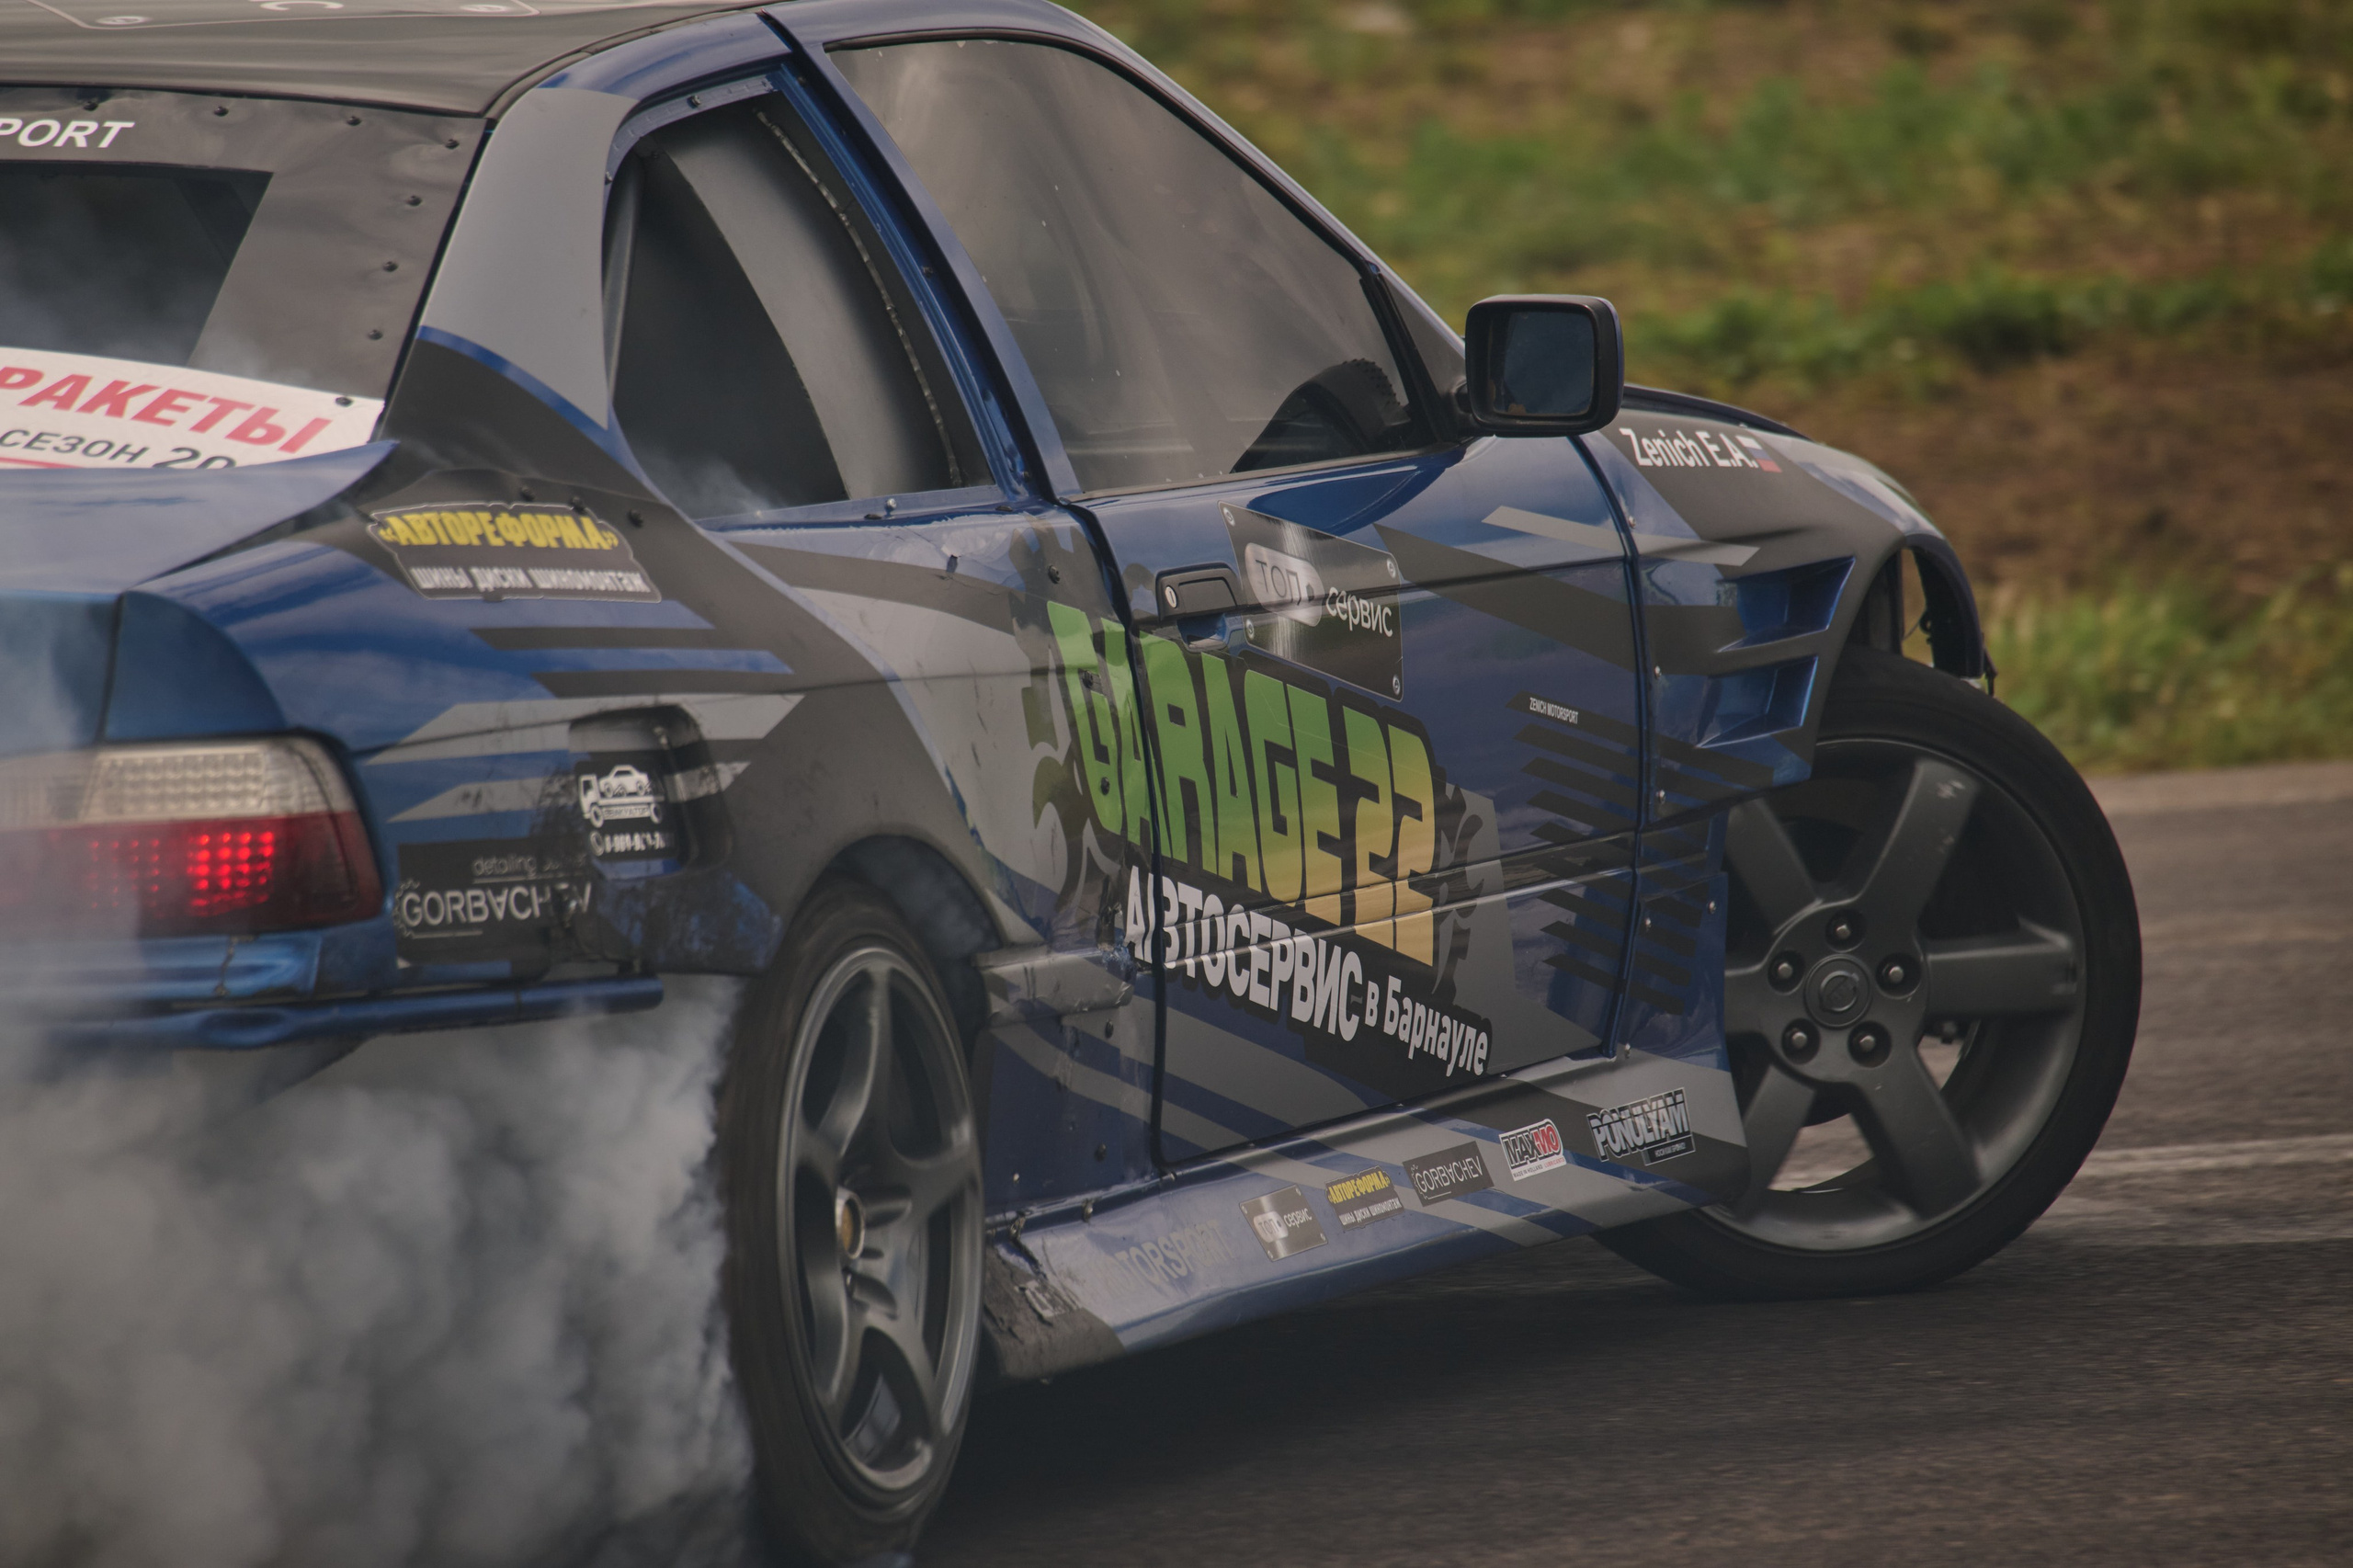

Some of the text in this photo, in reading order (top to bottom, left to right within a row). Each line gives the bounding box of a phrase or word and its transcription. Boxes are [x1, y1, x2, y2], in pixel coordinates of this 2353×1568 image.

[0, 366, 333, 454] РАКЕТЫ
[0, 428, 150, 463] СЕЗОН
[1619, 427, 1759, 468] Zenich E.A.
[1255, 559, 1393, 637] ТОП сервис
[1529, 697, 1578, 724] ZENICH MOTORSPORT
[472, 854, 537, 879] detailing
[401, 881, 592, 927] GORBACHV
[1123, 865, 1488, 1077] АВТОСЕРВИС в Барнауле
[1283, 1208, 1313, 1229] сервис
